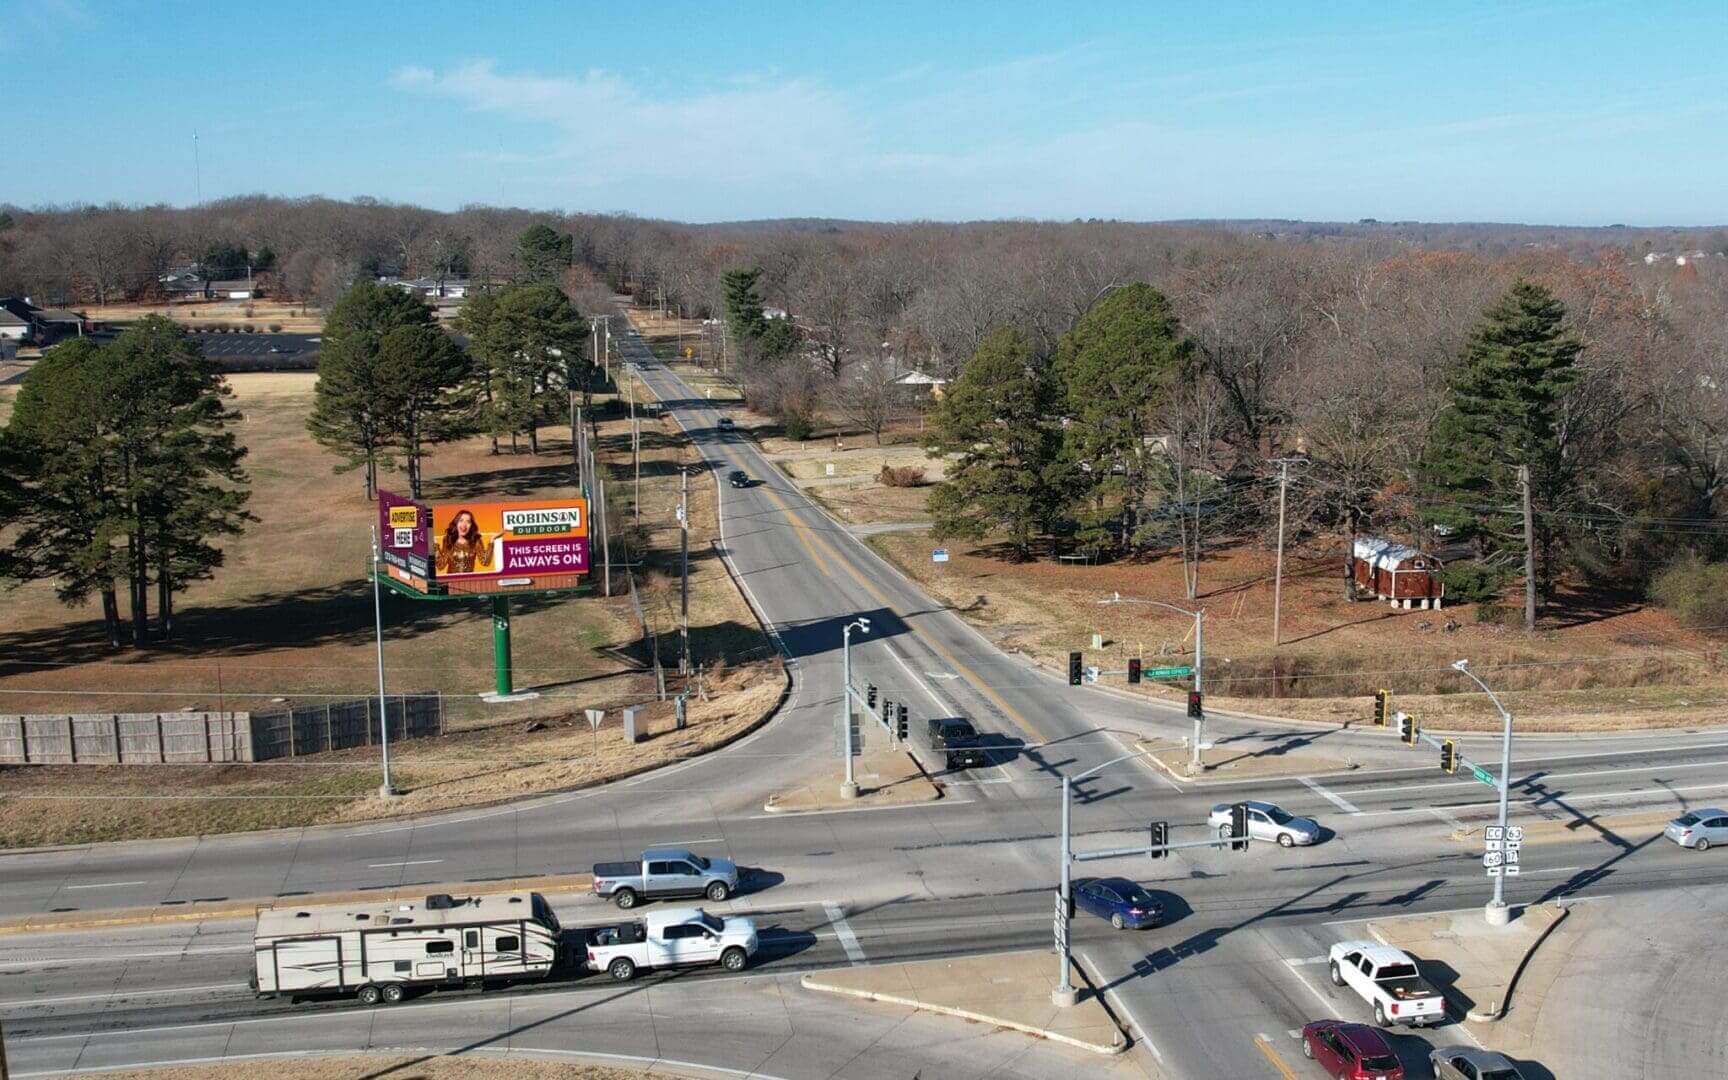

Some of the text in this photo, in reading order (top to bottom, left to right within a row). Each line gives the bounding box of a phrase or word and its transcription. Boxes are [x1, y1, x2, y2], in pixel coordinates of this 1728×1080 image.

[391, 511, 415, 522] ADVERTISE
[506, 511, 577, 525] ROBINSON
[517, 526, 568, 534] OUTDOOR
[396, 531, 411, 544] HERE
[509, 546, 531, 555] THIS
[533, 545, 570, 554] SCREEN
[509, 555, 582, 568] ALWAYS ON
[1488, 829, 1501, 838] CC
[1508, 829, 1520, 838] 63
[1485, 854, 1501, 865] 160
